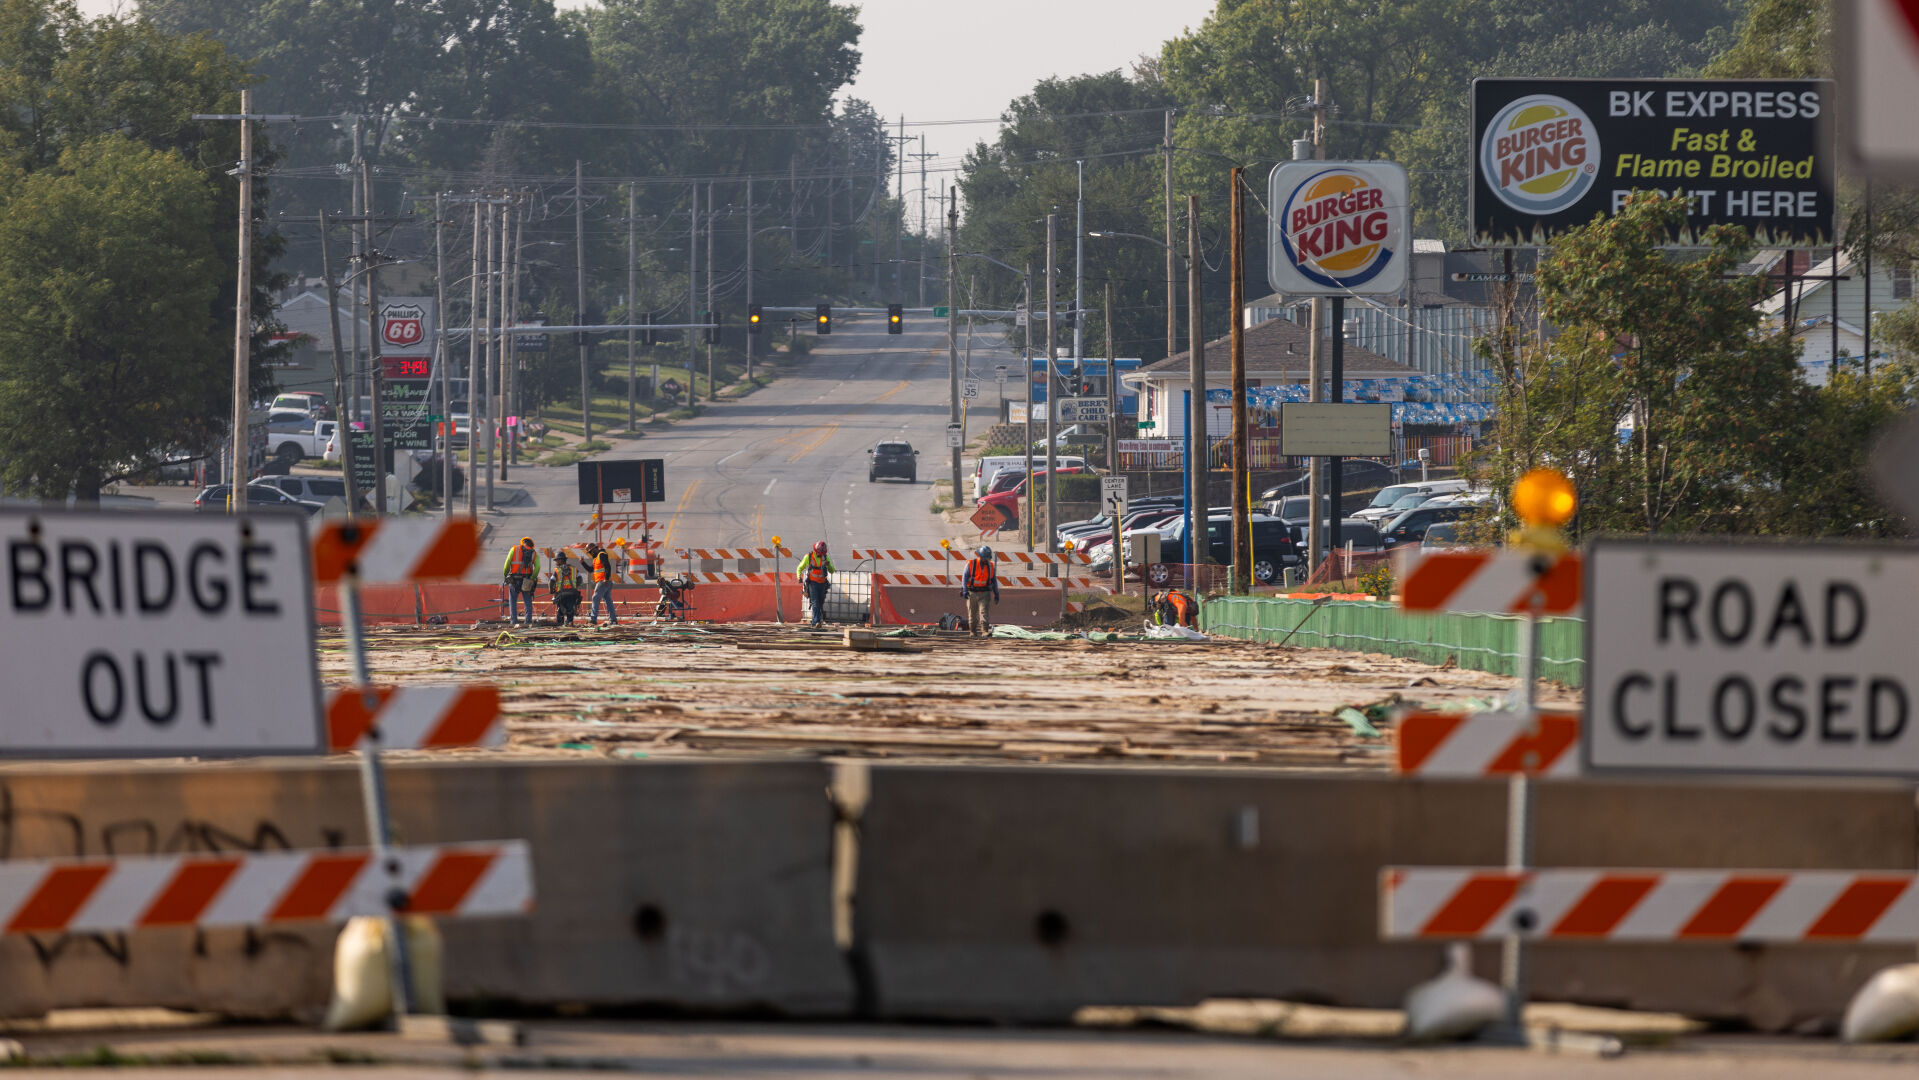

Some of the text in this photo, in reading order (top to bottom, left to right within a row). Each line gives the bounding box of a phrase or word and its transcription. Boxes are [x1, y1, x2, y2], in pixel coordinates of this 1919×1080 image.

[1608, 91, 1821, 119] BK EXPRESS
[1496, 117, 1583, 160] BURGER
[1670, 128, 1757, 152] Fast &
[1500, 137, 1587, 188] KING
[1615, 154, 1814, 179] Flame Broiled
[1292, 188, 1384, 234] BURGER
[1611, 189, 1817, 218] RHT HERE
[1297, 211, 1388, 266] KING
[1470, 273, 1507, 281] LAMAR
[387, 310, 419, 319] PHILLIPS
[388, 322, 417, 339] 66
[964, 387, 977, 397] 35
[1080, 407, 1105, 415] CHILD
[406, 439, 428, 447] WINE
[7, 538, 282, 617] BRIDGE
[1656, 574, 1868, 648] ROAD
[80, 649, 223, 729] OUT
[1611, 670, 1911, 745] CLOSED
